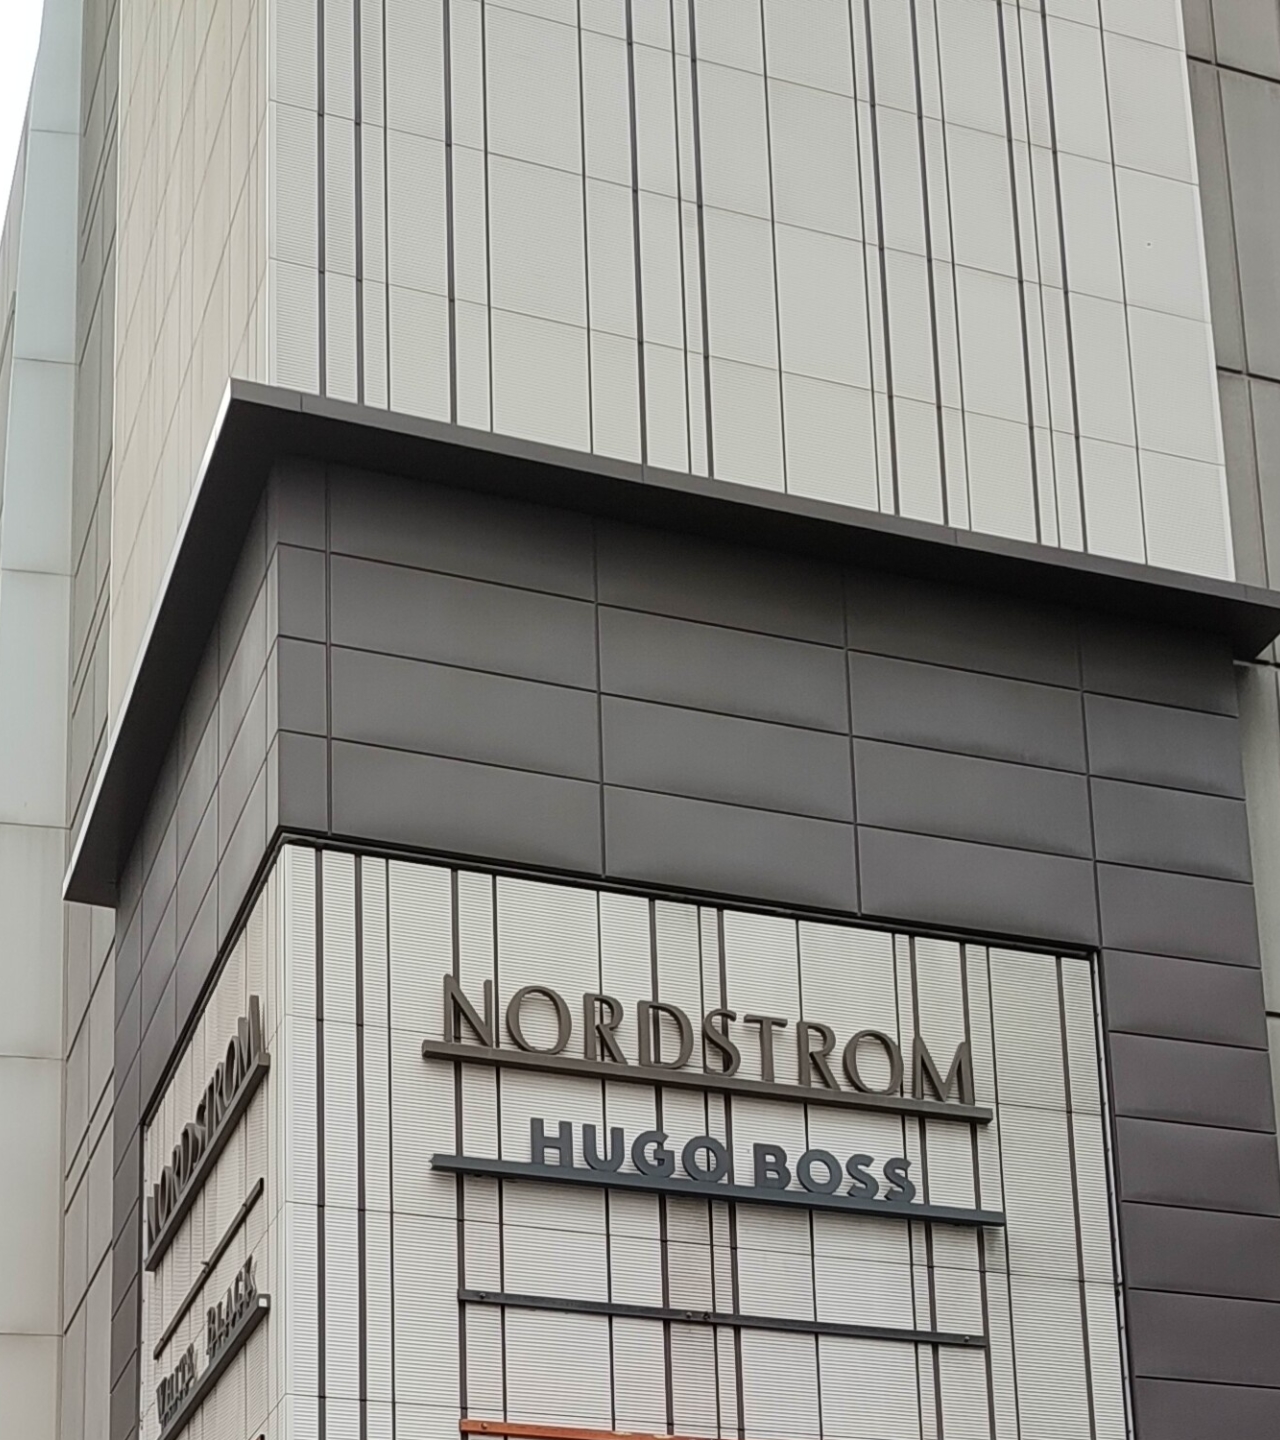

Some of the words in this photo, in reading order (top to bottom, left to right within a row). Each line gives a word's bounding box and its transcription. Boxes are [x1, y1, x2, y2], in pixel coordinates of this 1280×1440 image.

[442, 973, 976, 1106] NORDSTROM
[529, 1117, 729, 1184] HUGO
[752, 1142, 917, 1203] BOSS
